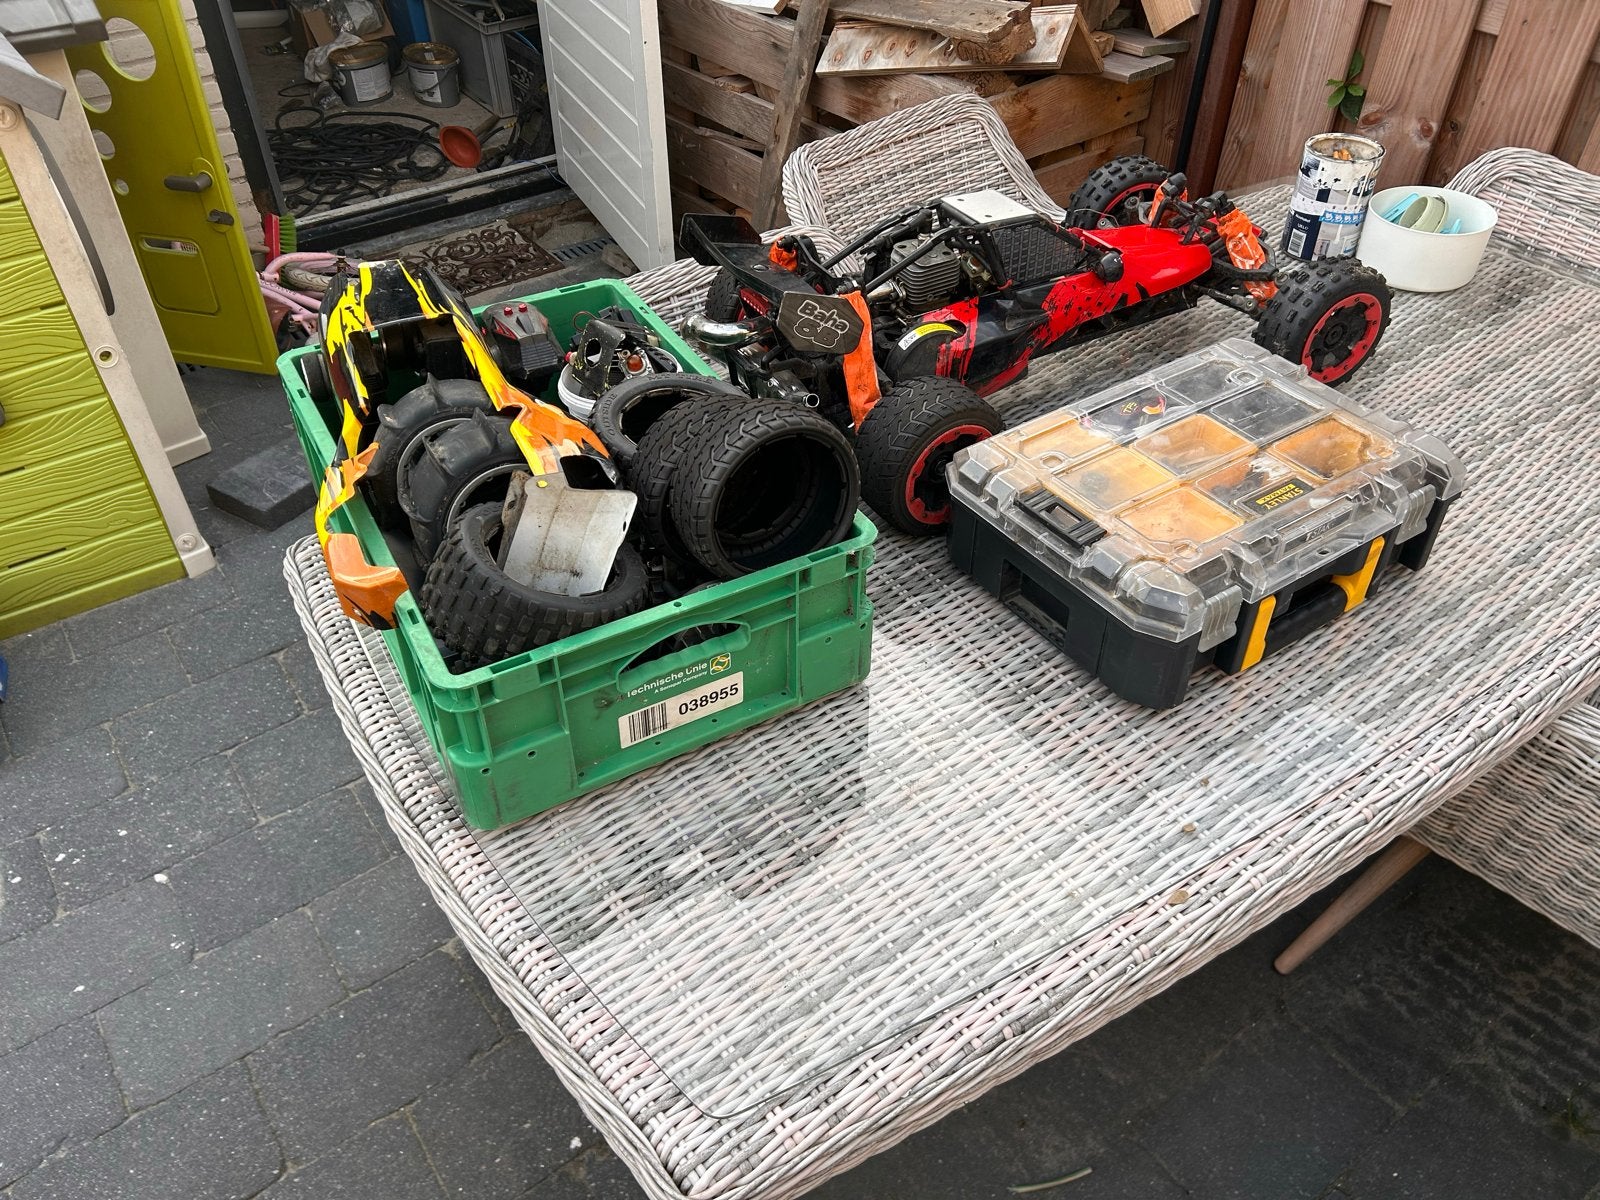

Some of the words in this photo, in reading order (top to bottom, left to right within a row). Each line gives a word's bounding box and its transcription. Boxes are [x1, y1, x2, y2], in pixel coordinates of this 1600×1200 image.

[798, 300, 849, 334] Baha
[1263, 487, 1304, 510] STANLEY
[627, 671, 684, 698] Technische
[685, 662, 708, 675] Unie
[682, 670, 708, 683] Company
[678, 683, 739, 715] 038955
